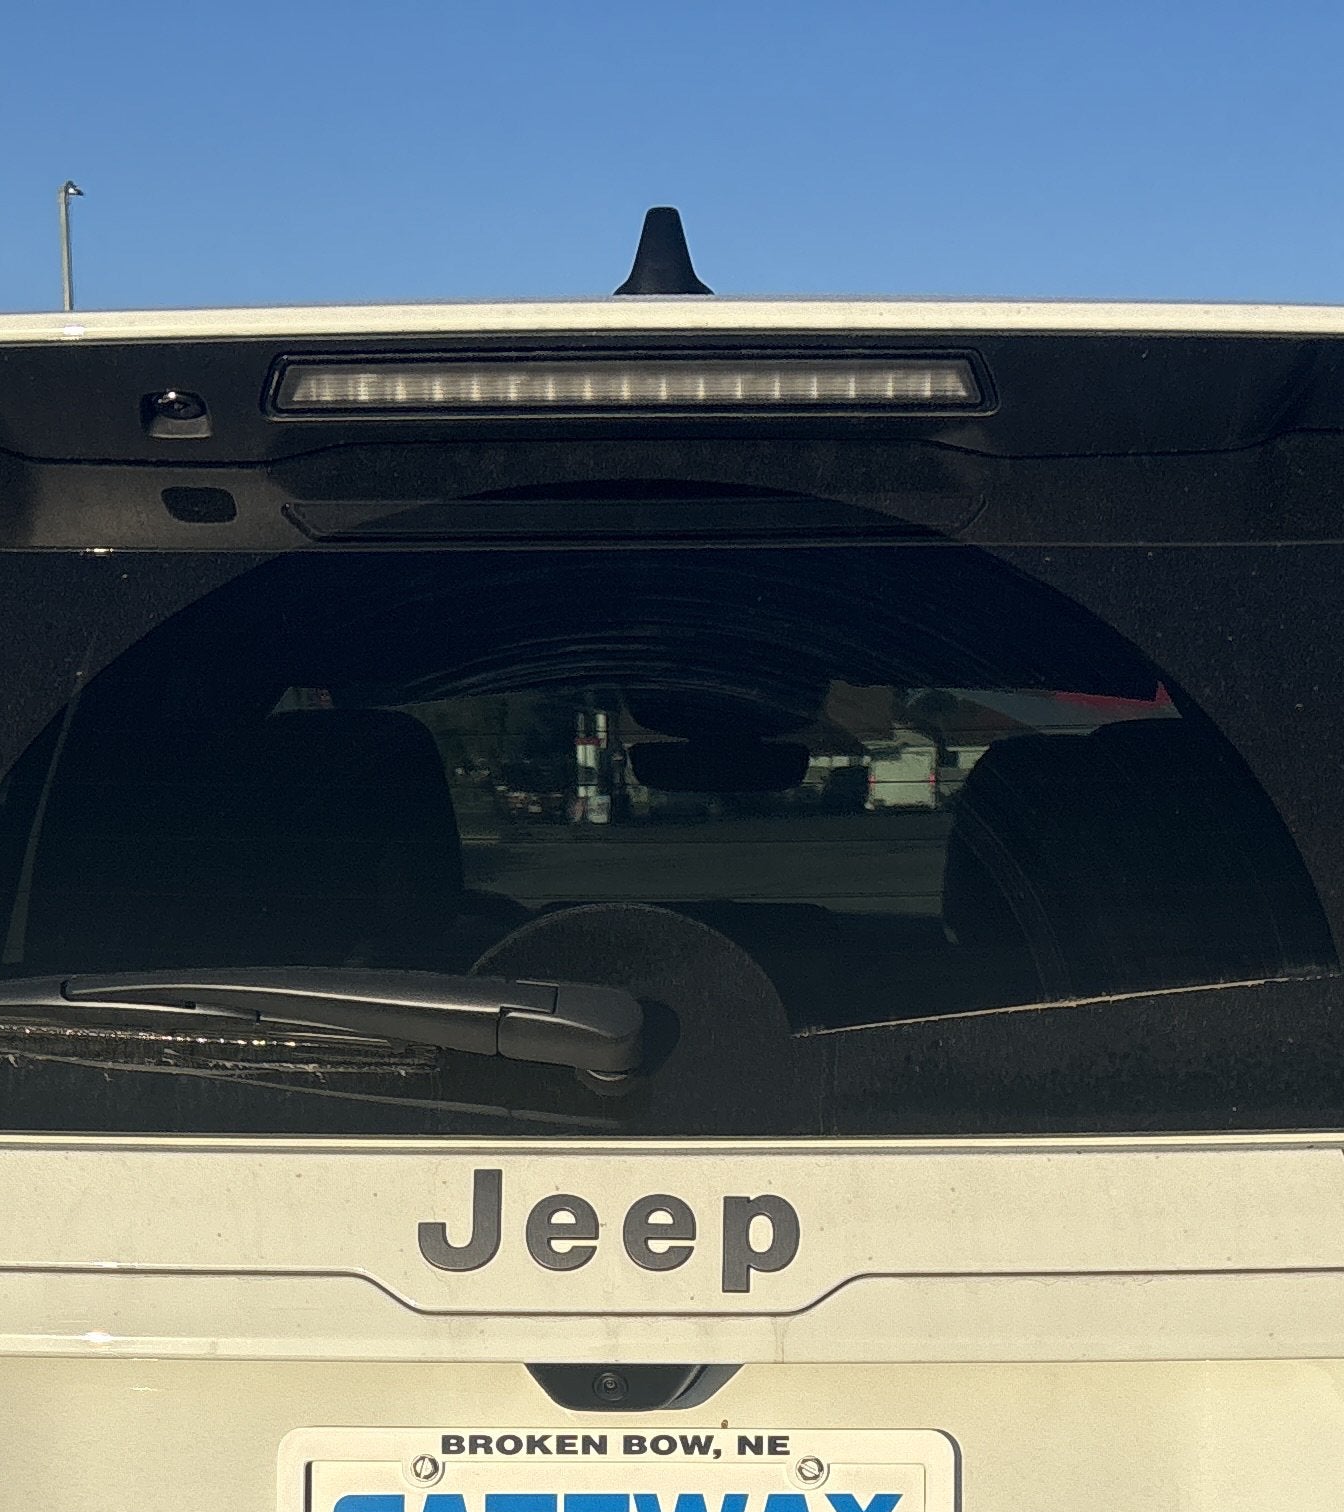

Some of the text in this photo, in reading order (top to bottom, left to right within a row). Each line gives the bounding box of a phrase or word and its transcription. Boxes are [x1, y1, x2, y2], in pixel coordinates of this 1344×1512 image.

[418, 1169, 800, 1293] Jeep
[441, 1434, 790, 1460] BROKEN BOW, NE
